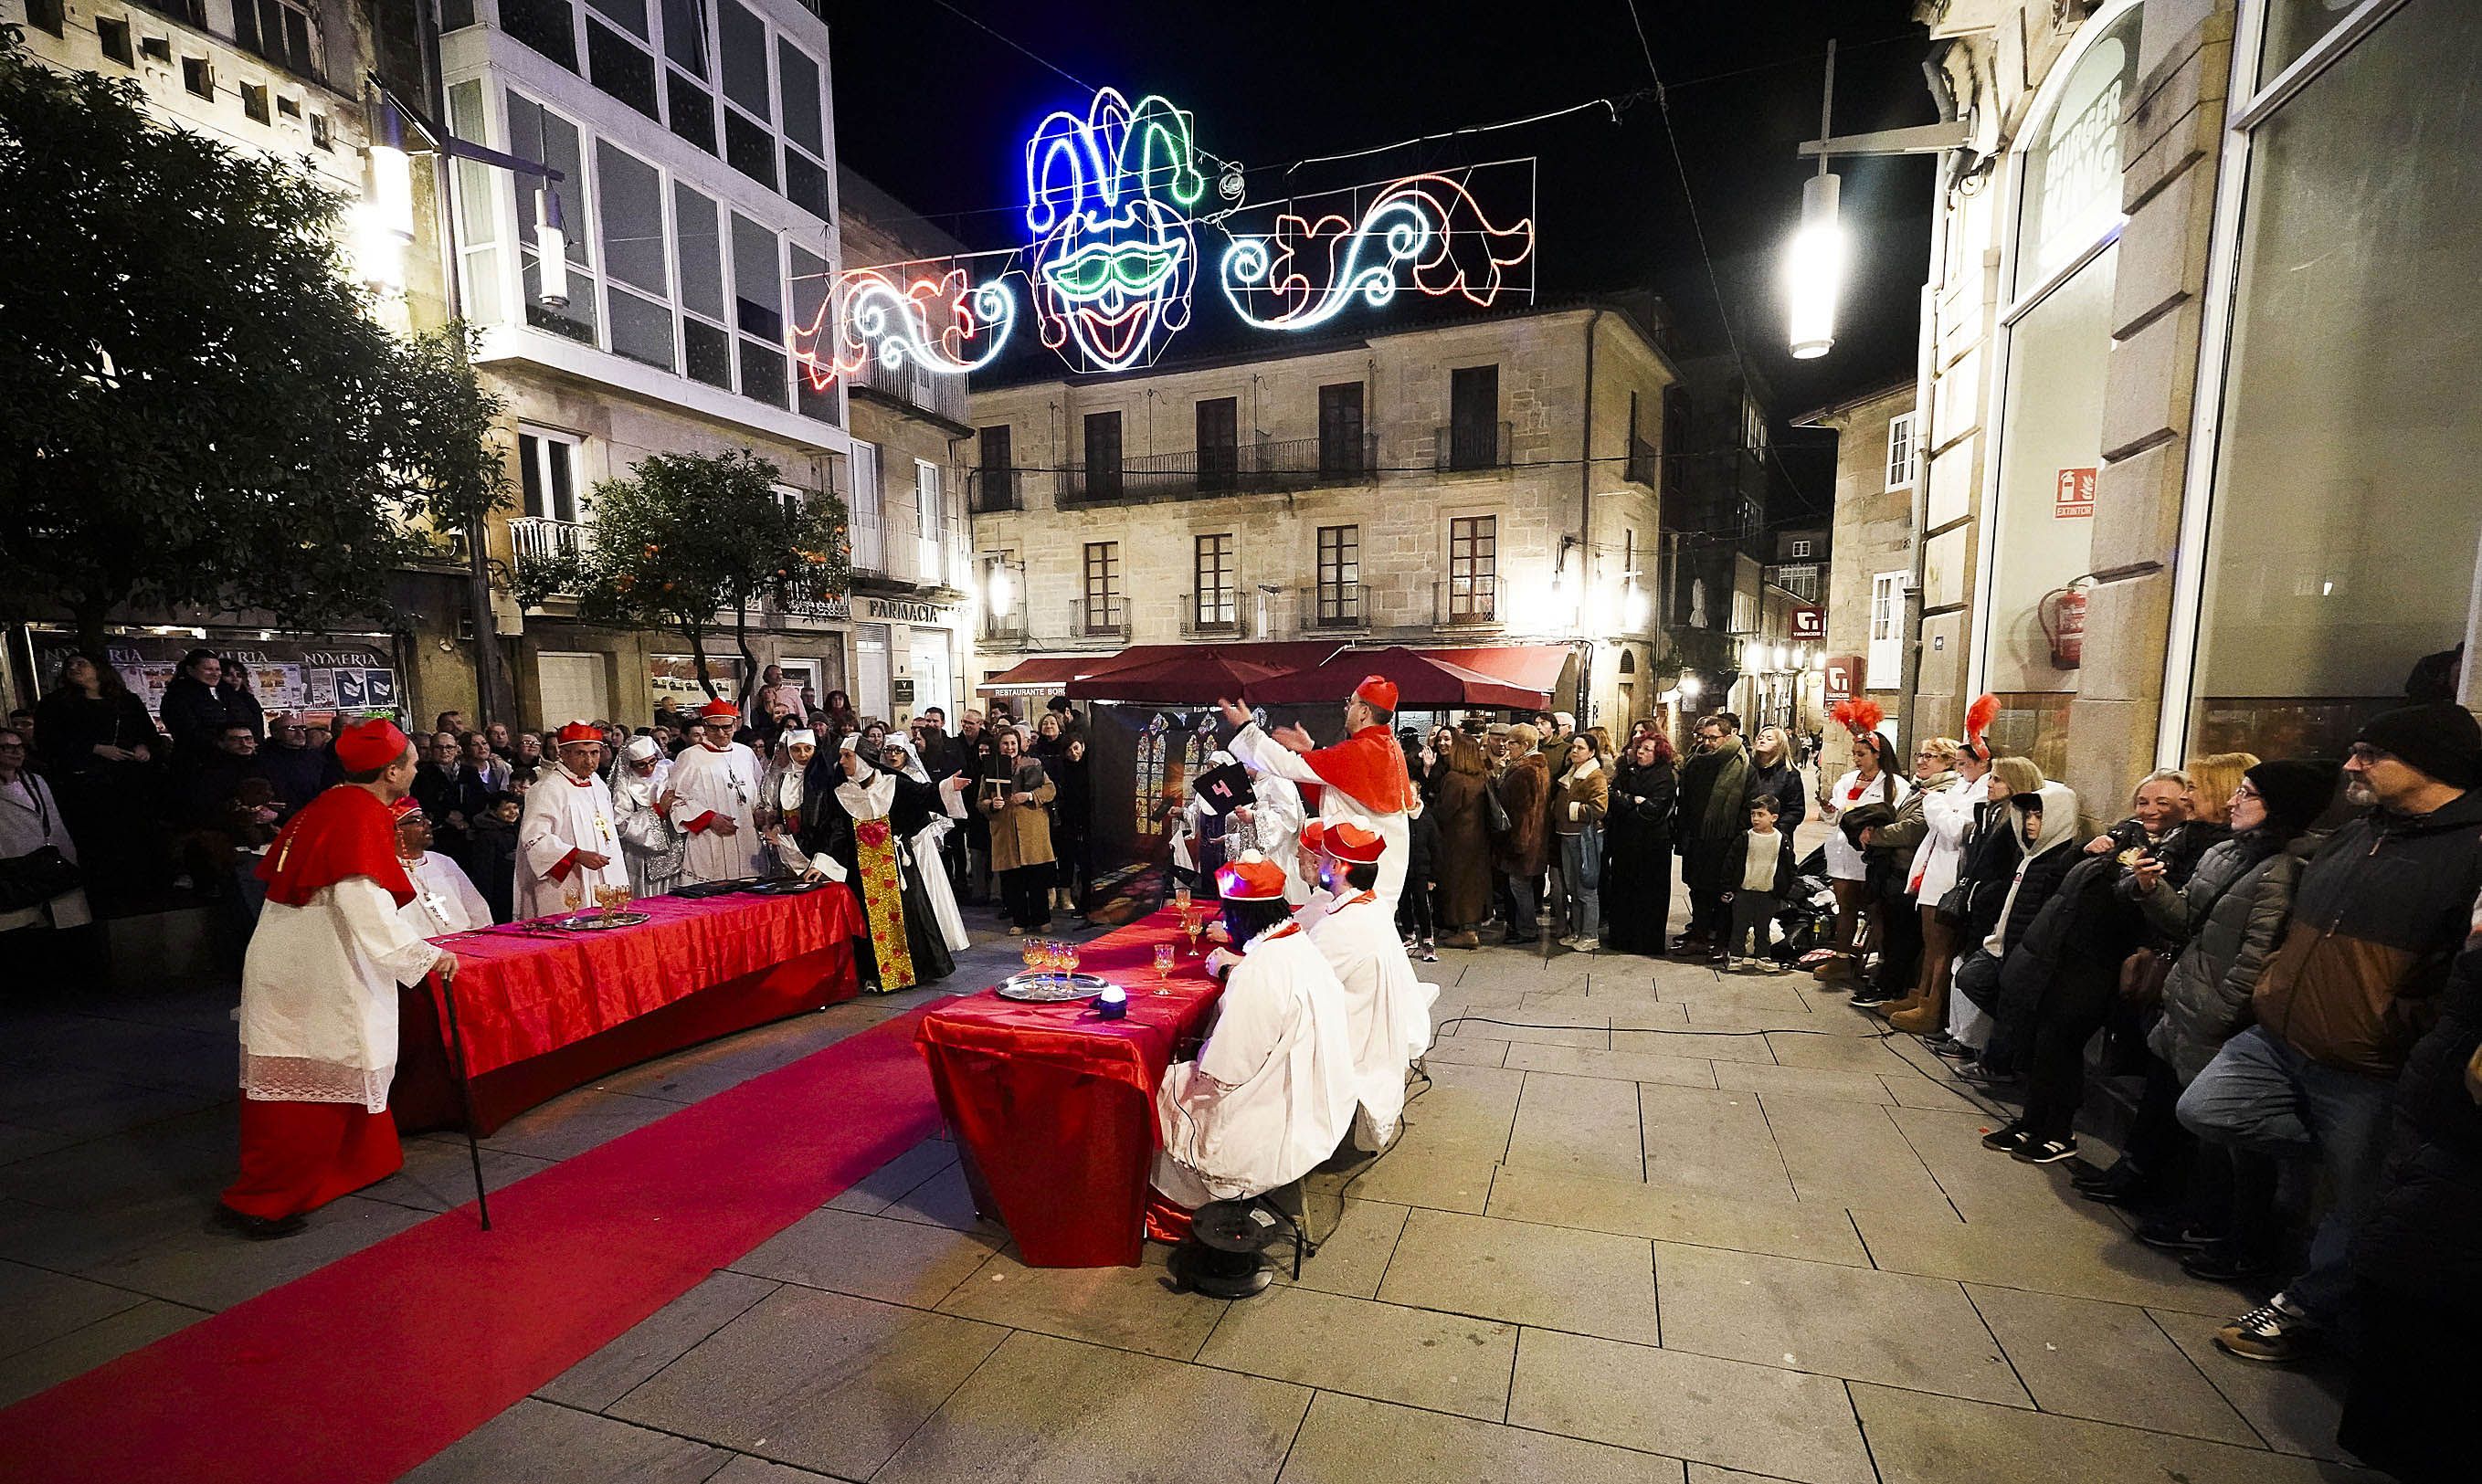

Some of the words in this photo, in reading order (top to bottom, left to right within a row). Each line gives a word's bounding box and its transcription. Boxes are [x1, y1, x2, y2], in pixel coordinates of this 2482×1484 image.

[2045, 79, 2122, 191] BURGER
[870, 599, 938, 623] FARMACIA
[45, 647, 144, 663] NYRIA
[301, 651, 380, 668] NYMERIA
[995, 688, 1045, 696] RESTAURANTE
